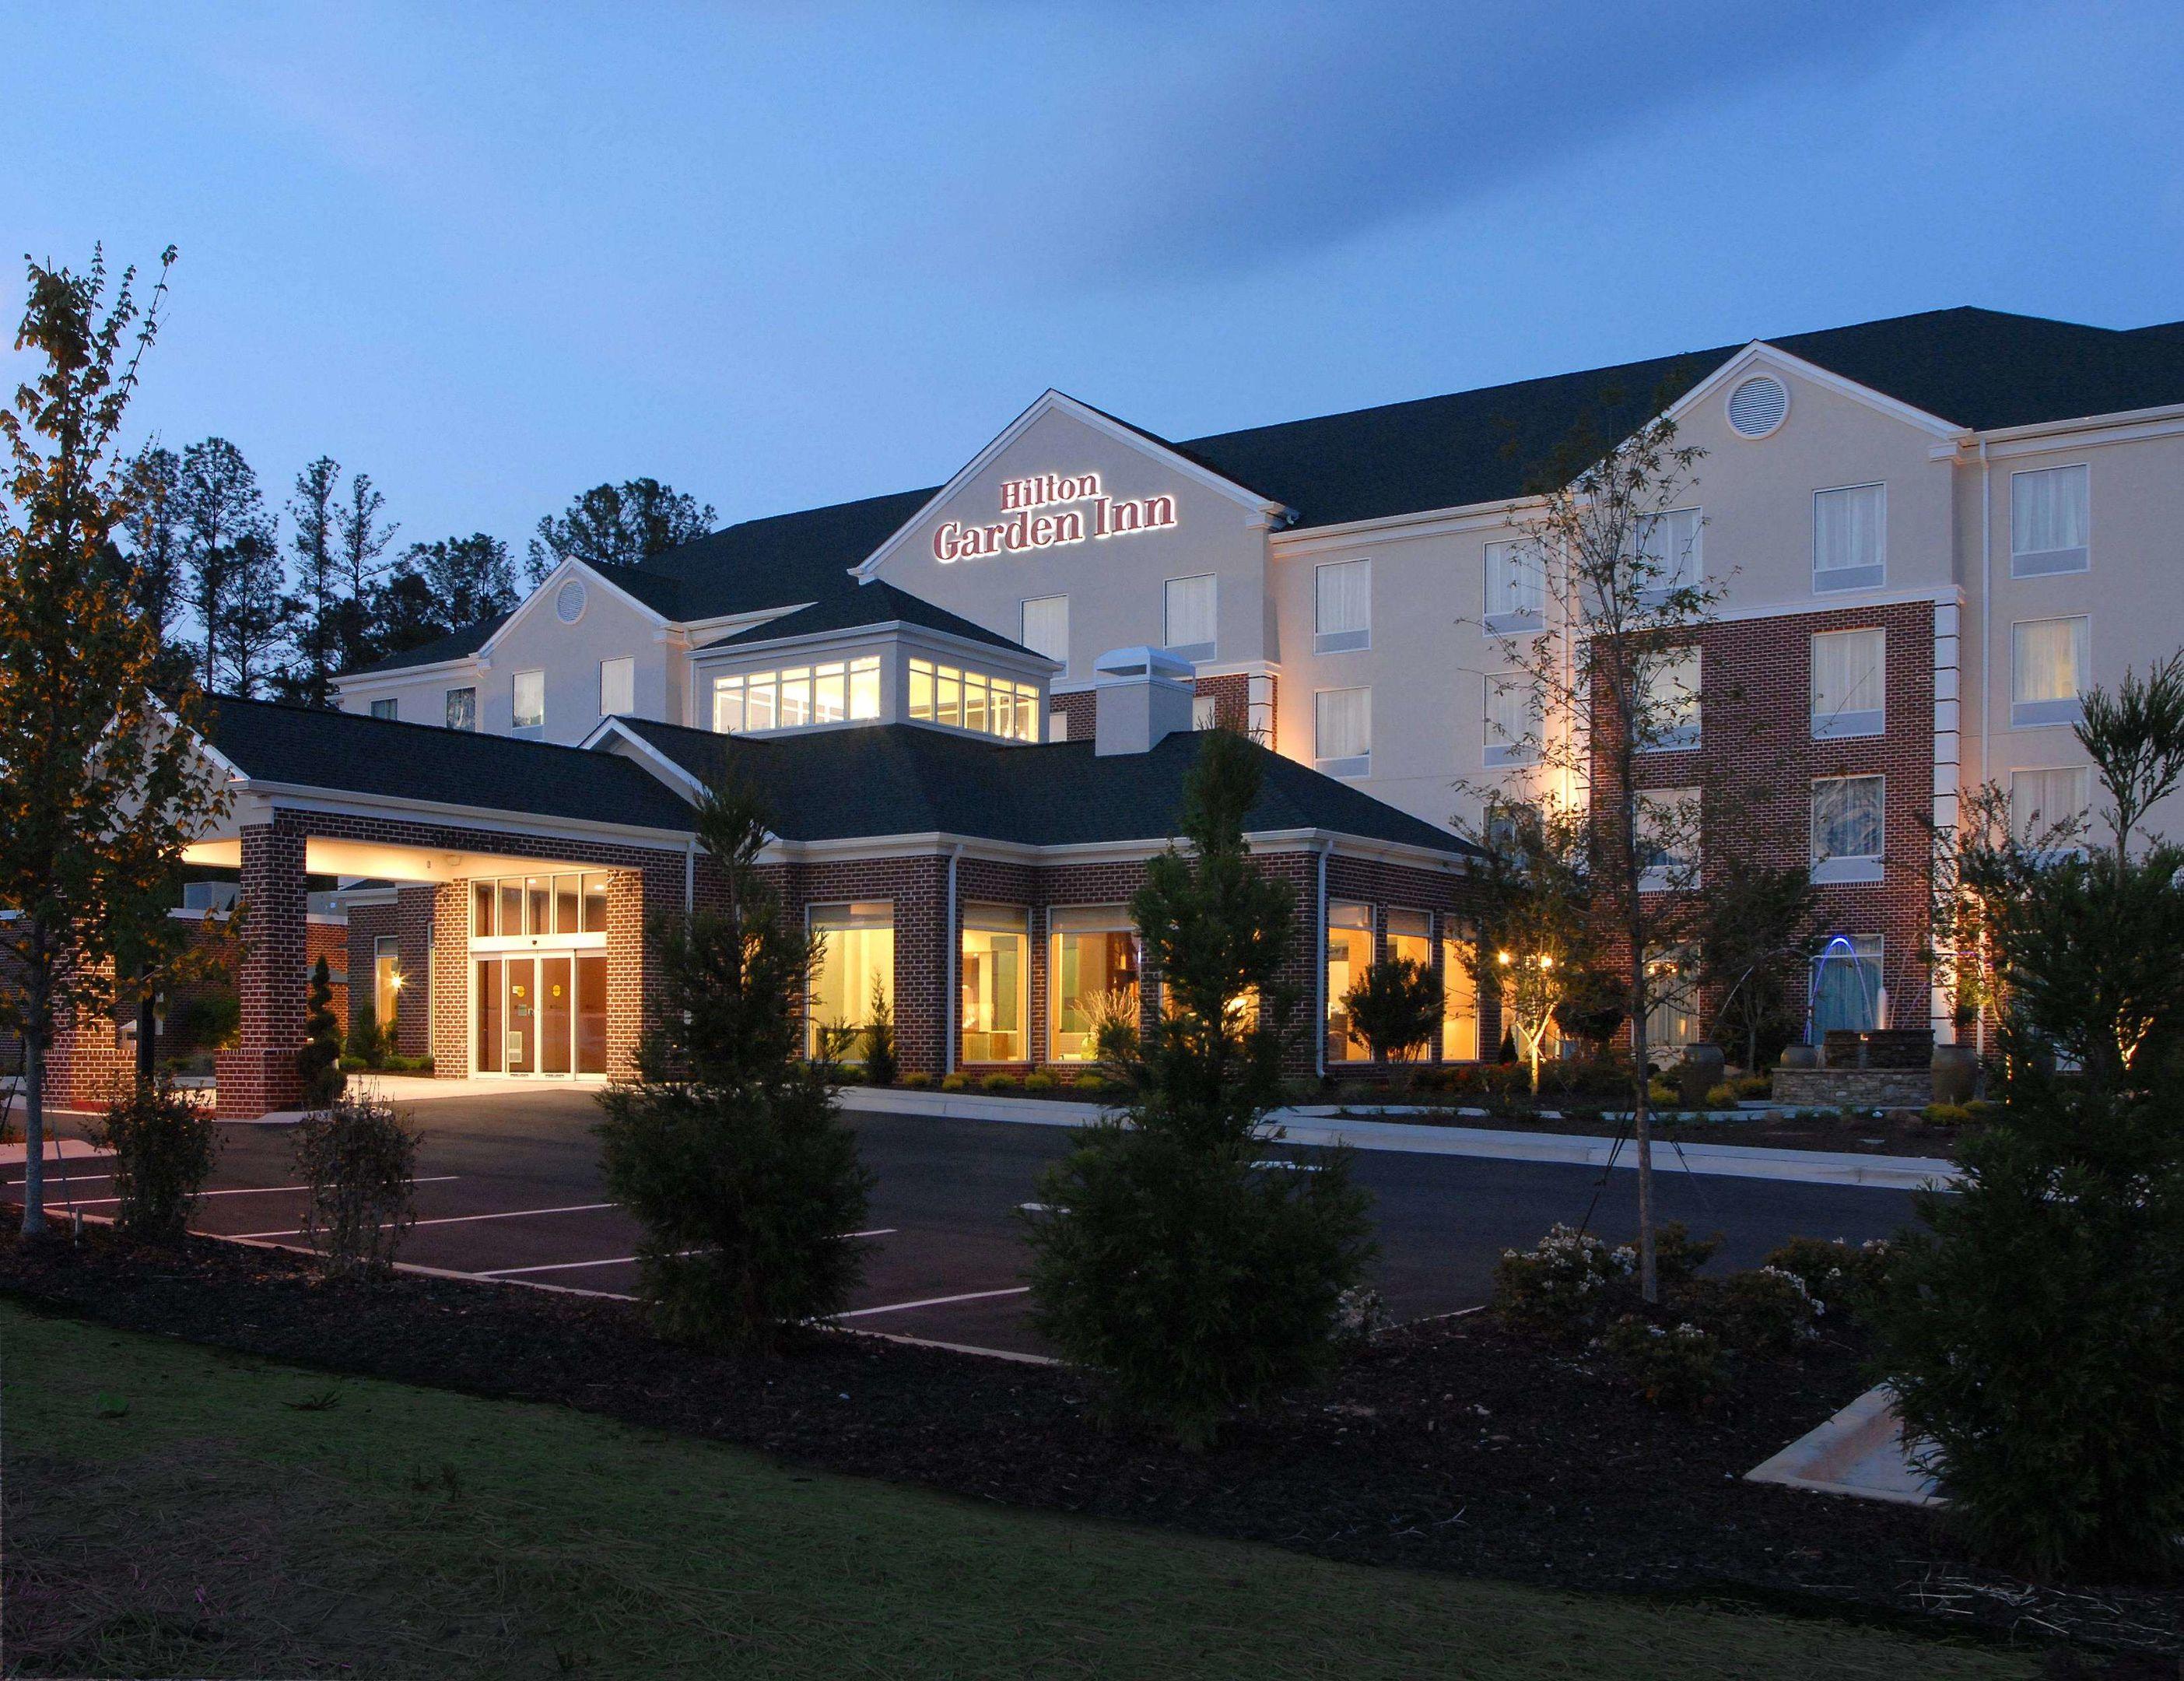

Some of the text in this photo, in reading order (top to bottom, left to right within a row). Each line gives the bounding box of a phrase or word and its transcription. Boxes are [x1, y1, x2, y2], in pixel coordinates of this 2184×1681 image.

[1000, 473, 1099, 511] Hilton
[933, 495, 1176, 561] Garden Inn
